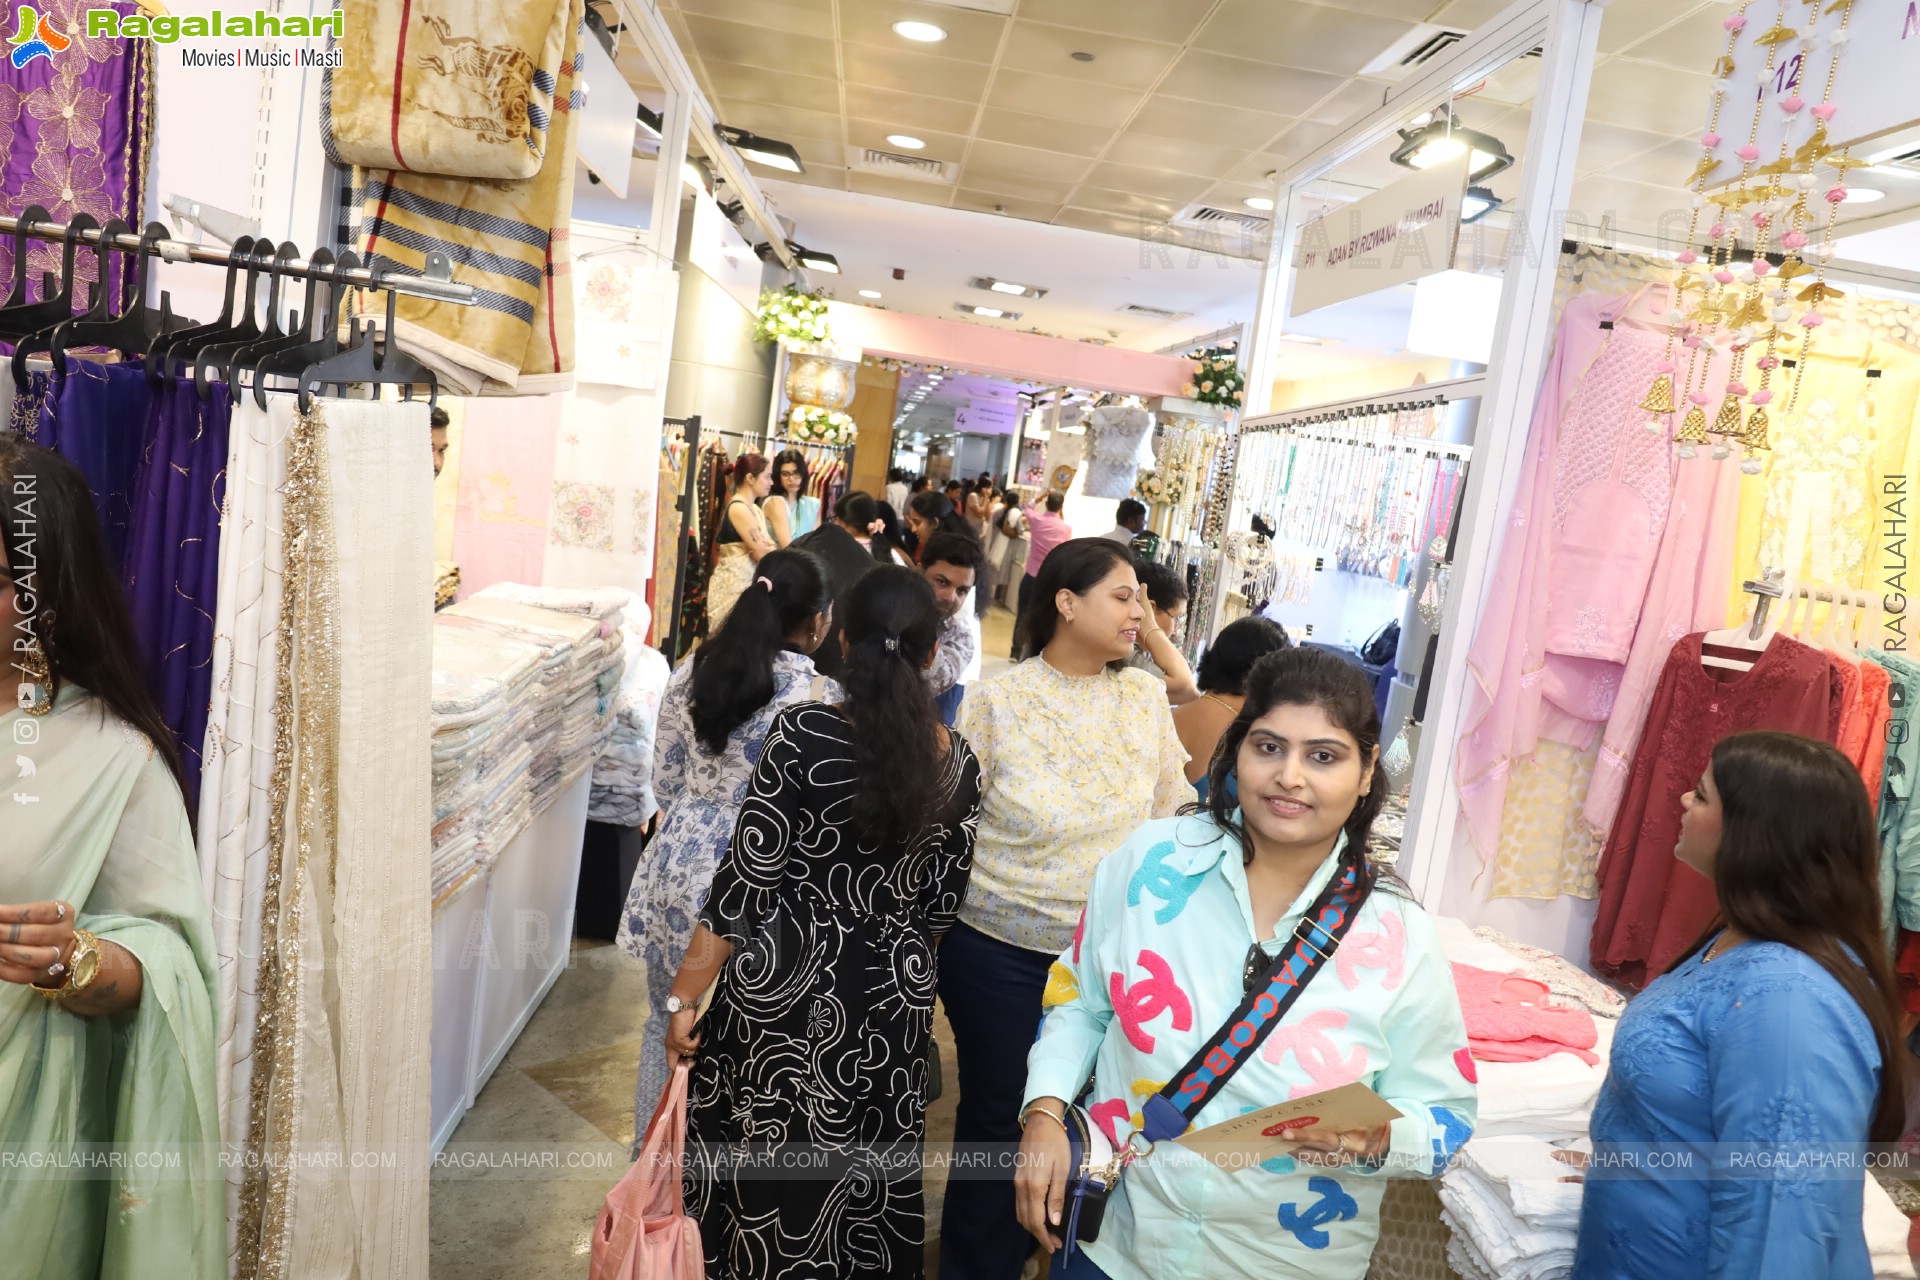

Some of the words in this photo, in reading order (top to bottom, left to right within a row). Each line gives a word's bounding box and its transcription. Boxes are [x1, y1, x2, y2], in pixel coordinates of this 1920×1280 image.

[1757, 53, 1804, 102] 12
[1327, 244, 1347, 266] ADAN
[1348, 238, 1361, 259] BY
[1180, 940, 1316, 1104] JACOBS
